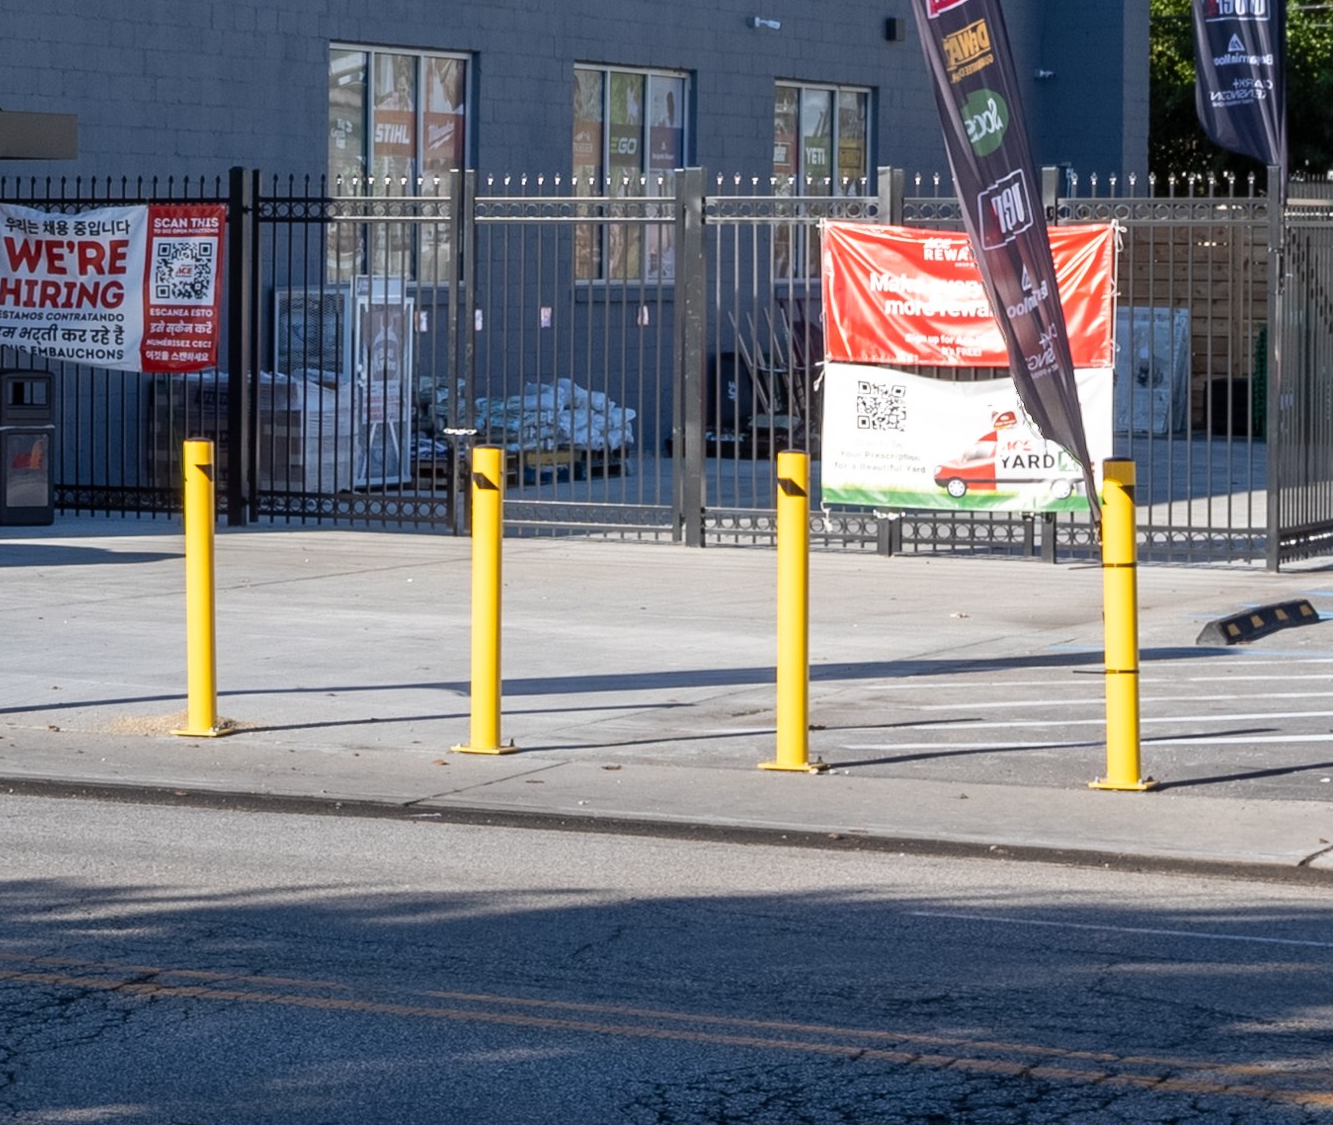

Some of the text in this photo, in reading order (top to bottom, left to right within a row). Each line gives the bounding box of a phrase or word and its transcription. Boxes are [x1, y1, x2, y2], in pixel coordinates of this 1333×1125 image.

[375, 123, 410, 144] STIHL
[611, 137, 637, 154] EGO
[806, 147, 825, 165] YETI
[5, 217, 39, 234] 우리는
[73, 219, 130, 236] 중입니다
[154, 217, 219, 228] SCAN THIS
[4, 237, 129, 276] WE'RE
[924, 247, 976, 261] REWA
[46, 312, 124, 322] CONTRATANDO
[149, 308, 213, 317] ESCANEA ESTO
[30, 346, 124, 360] EMBAUCHONS
[1001, 454, 1055, 469] YARD
